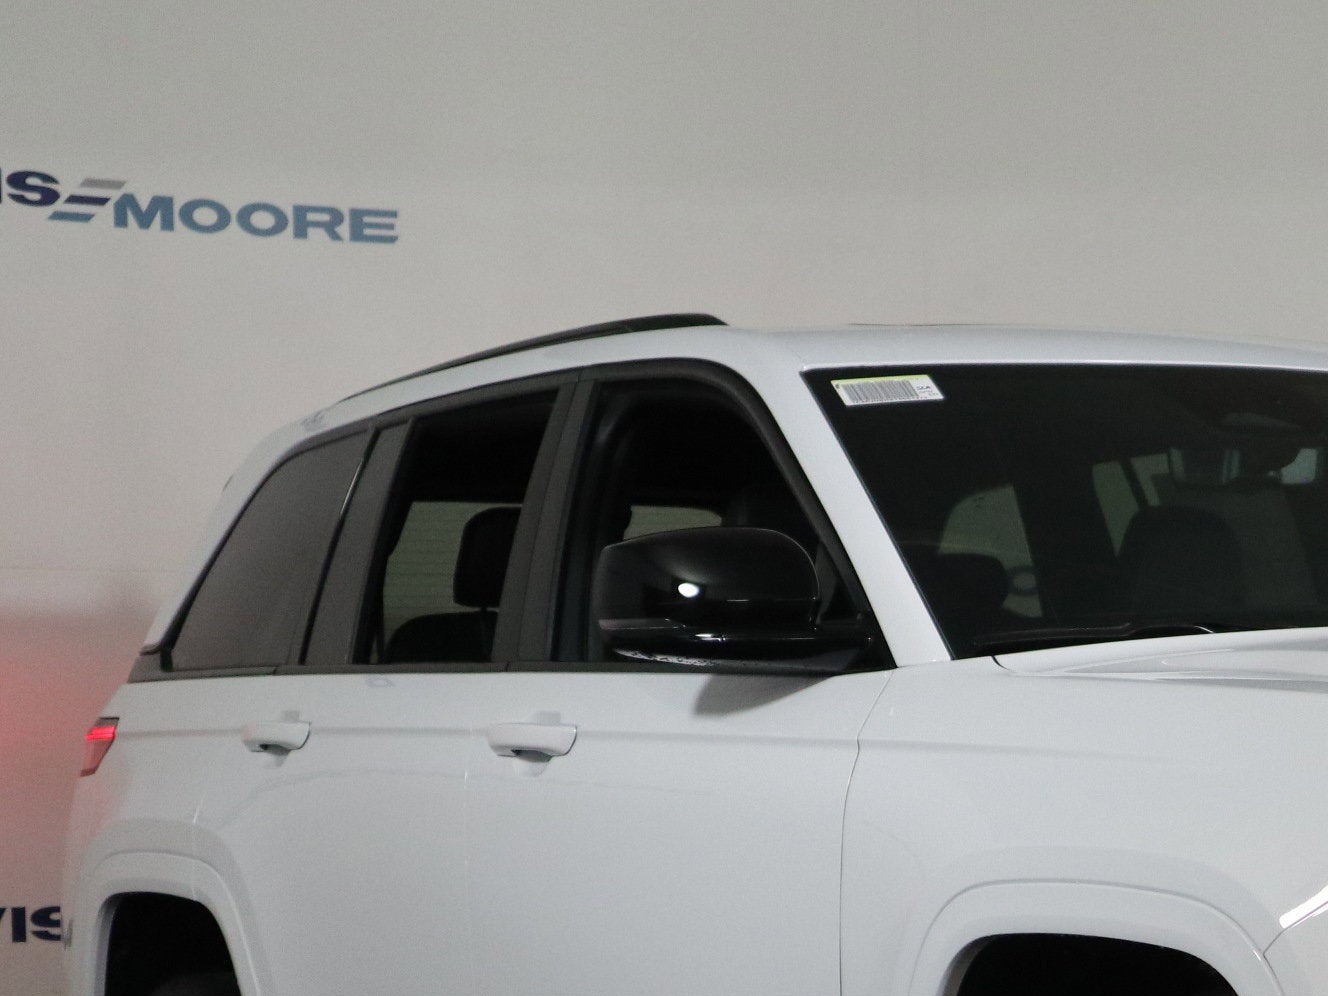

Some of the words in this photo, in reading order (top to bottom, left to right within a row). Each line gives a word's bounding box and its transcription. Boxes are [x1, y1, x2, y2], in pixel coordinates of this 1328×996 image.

[0, 168, 61, 207] S
[113, 193, 399, 244] MOORE
[0, 906, 62, 942] IS
